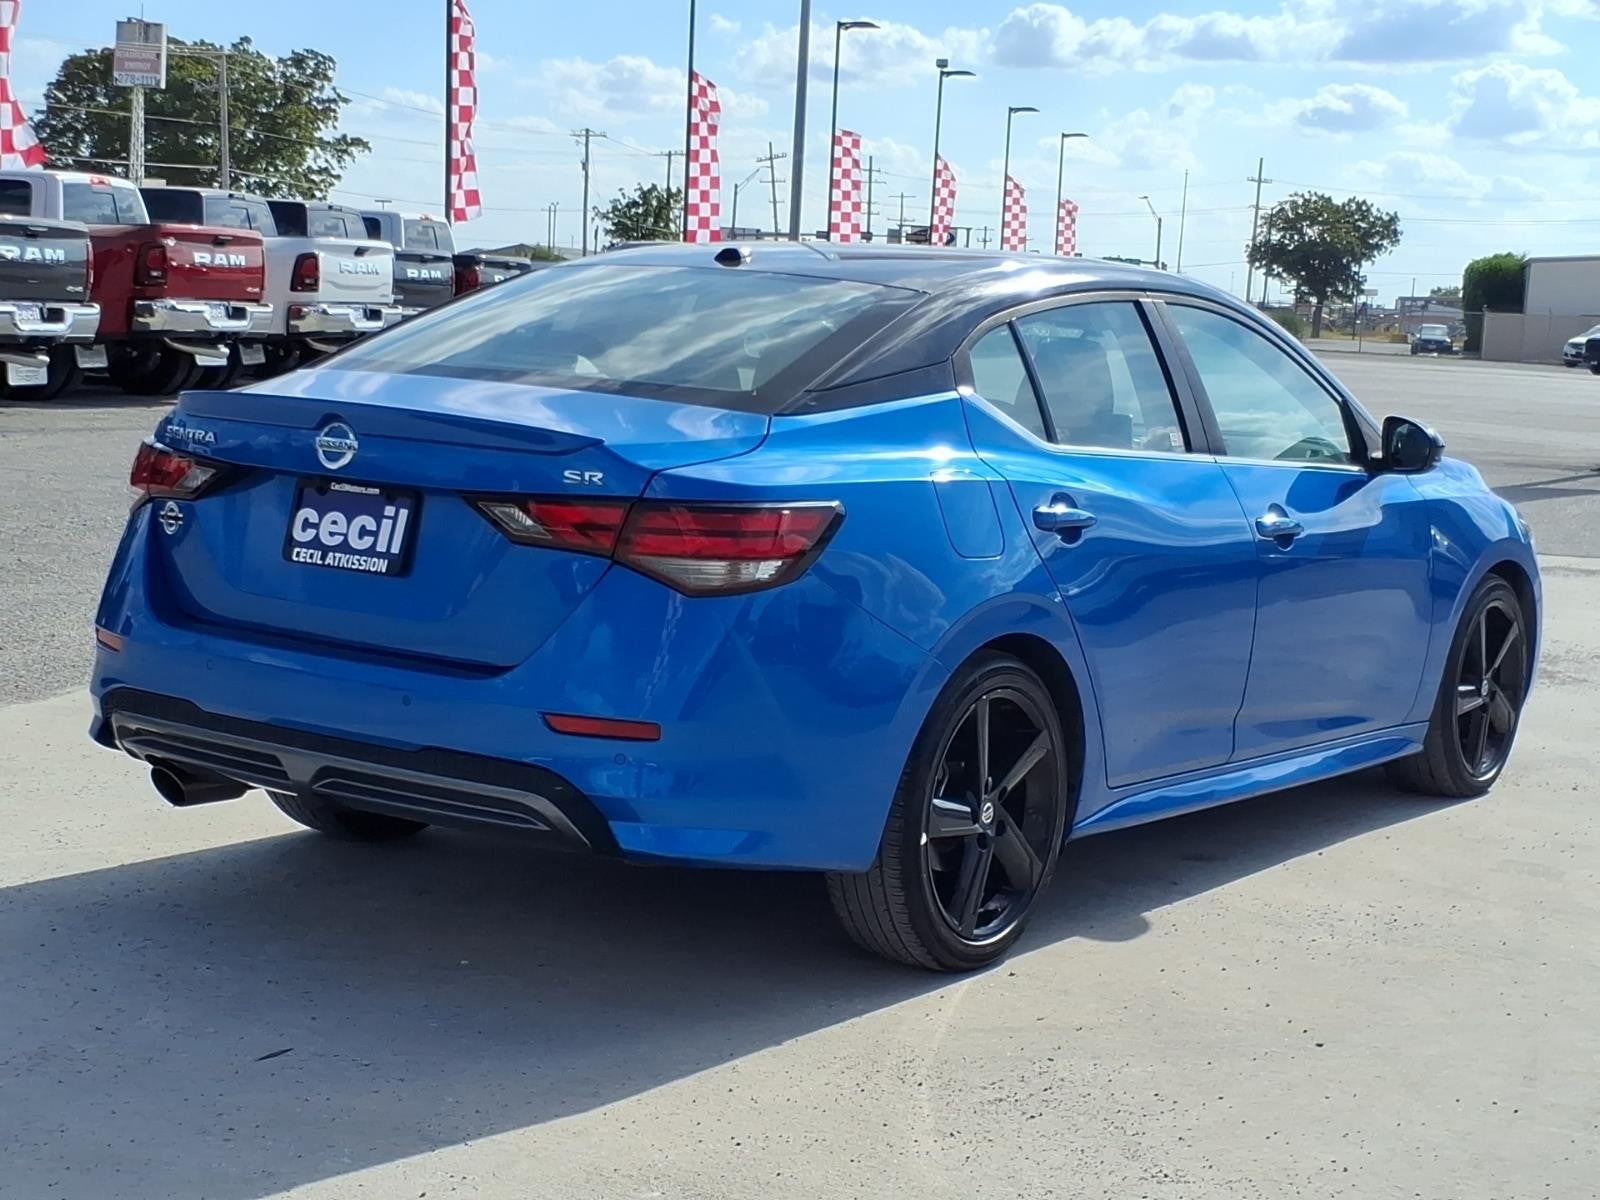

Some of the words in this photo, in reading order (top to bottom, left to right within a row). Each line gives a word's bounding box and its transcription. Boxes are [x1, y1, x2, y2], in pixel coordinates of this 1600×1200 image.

[0, 245, 65, 264] RAM
[193, 251, 246, 267] RAM
[339, 261, 379, 275] RAM
[406, 268, 442, 279] RAM
[165, 425, 216, 443] SENTRA
[318, 439, 354, 451] NISSAN
[563, 469, 604, 485] SR
[292, 505, 409, 554] cecil
[292, 547, 323, 565] CECIL
[324, 552, 389, 573] ATKISSION
